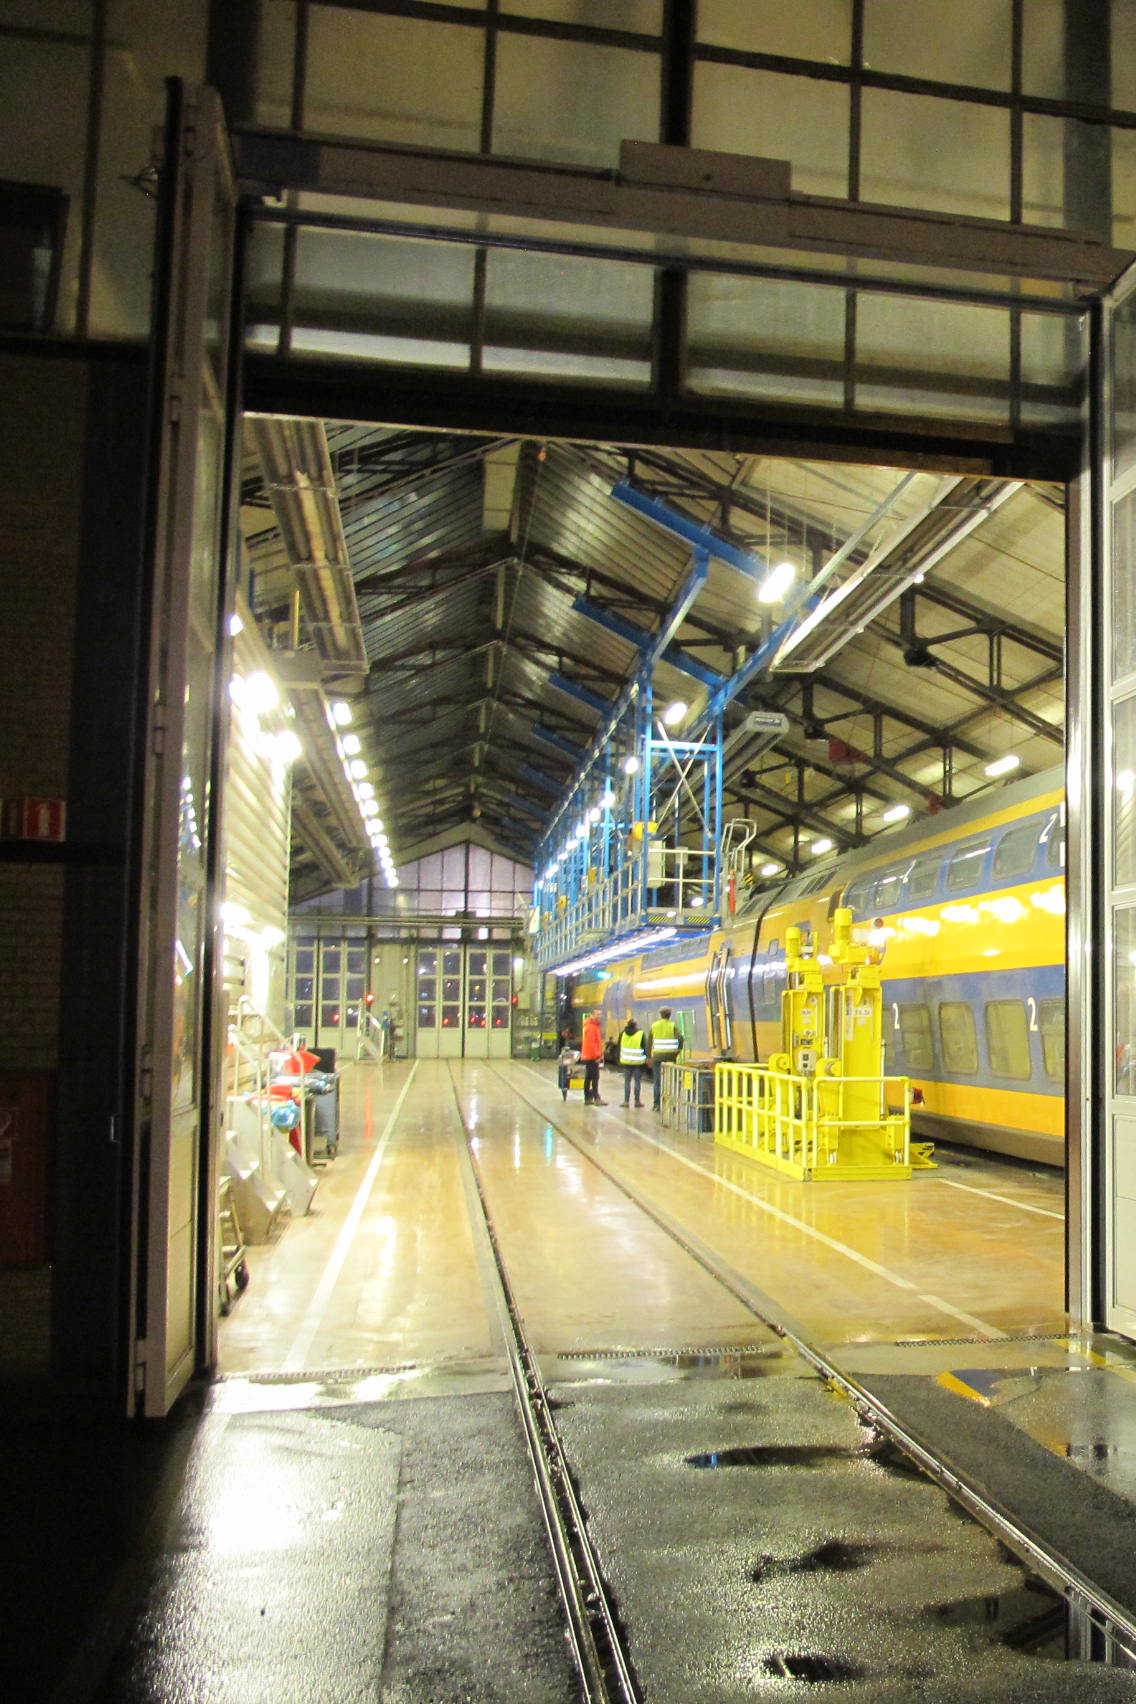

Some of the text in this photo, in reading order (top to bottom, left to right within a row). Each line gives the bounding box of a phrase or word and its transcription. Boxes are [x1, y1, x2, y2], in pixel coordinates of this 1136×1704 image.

[1039, 812, 1058, 844] 2
[892, 1002, 900, 1030] 2
[1027, 996, 1038, 1031] 2
